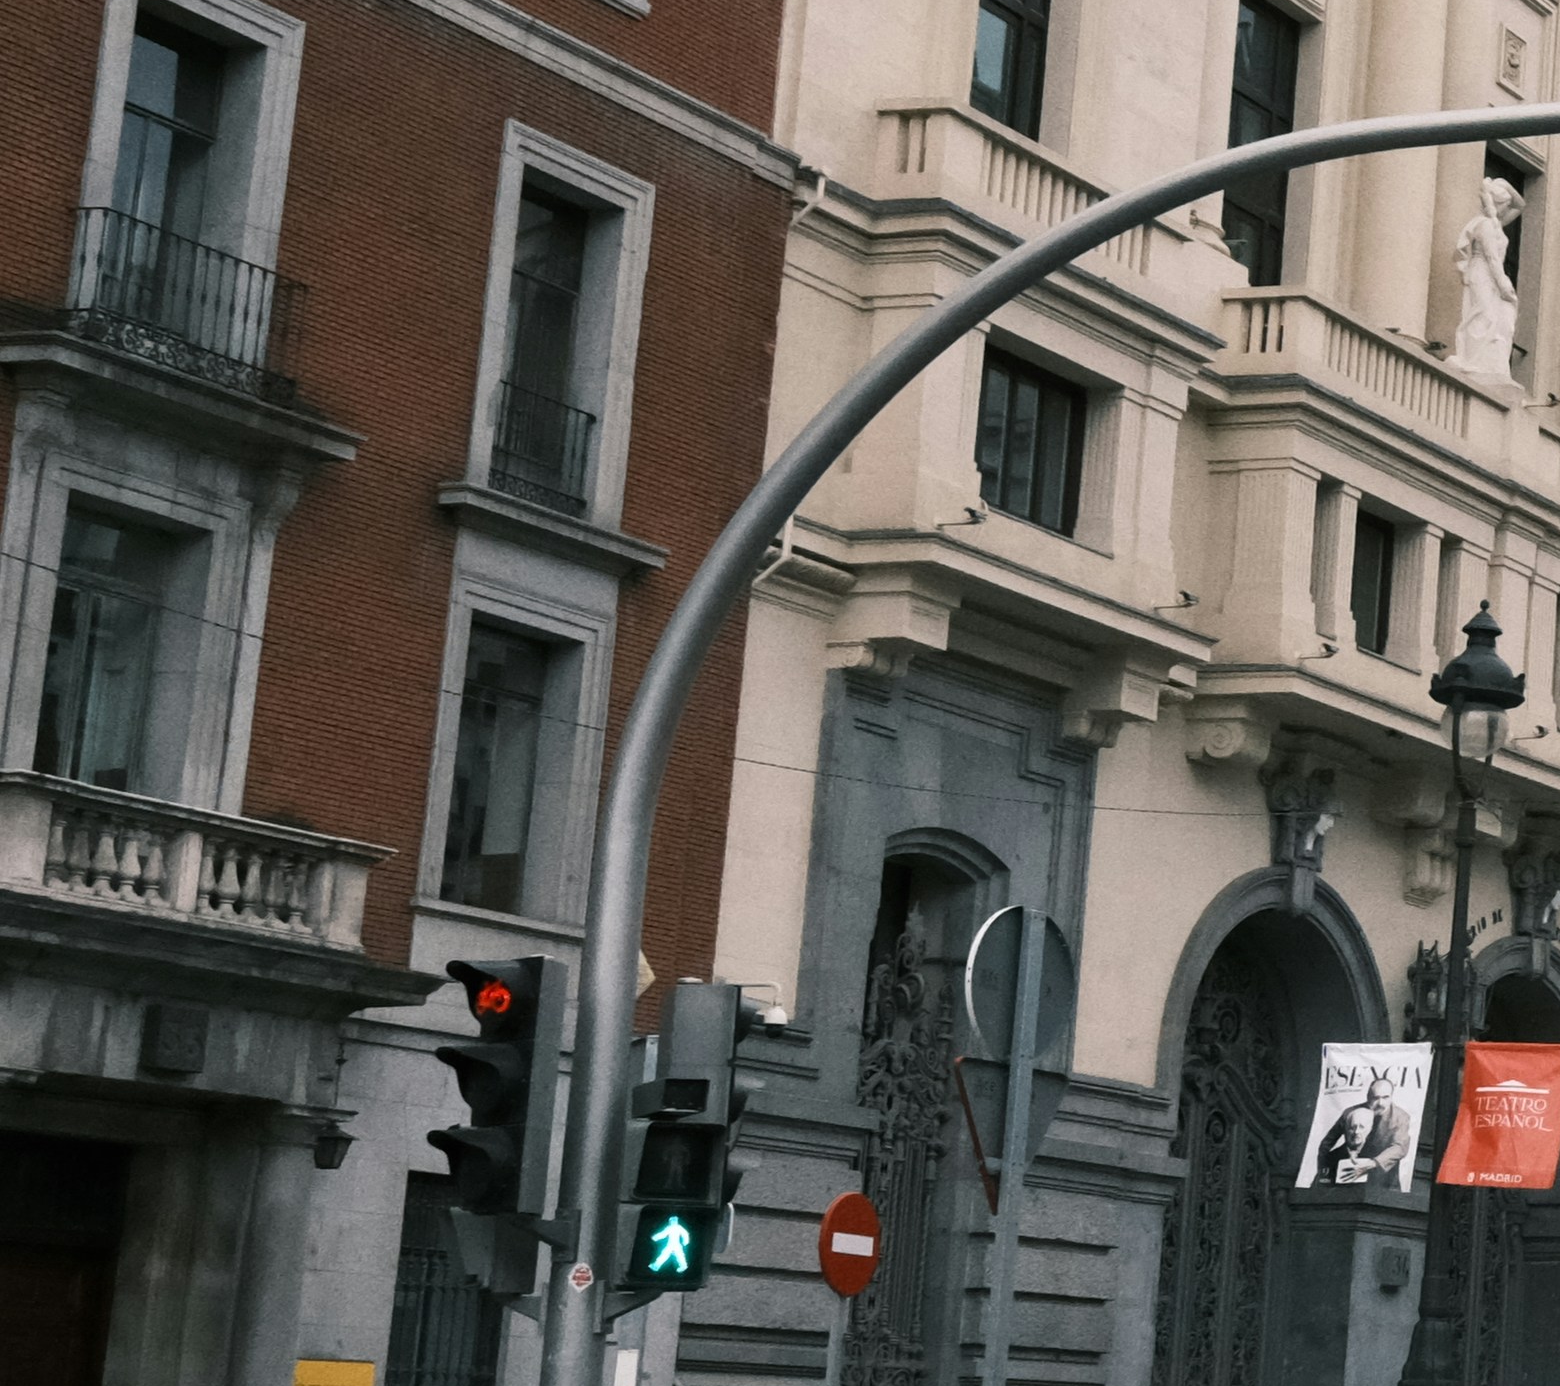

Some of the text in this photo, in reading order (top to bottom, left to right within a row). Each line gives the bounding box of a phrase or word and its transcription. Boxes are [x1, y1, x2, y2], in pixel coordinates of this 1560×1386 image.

[1475, 1095, 1547, 1114] TEATRO
[1474, 1111, 1553, 1132] ESPAÑOL
[1479, 1172, 1523, 1184] MADRID
